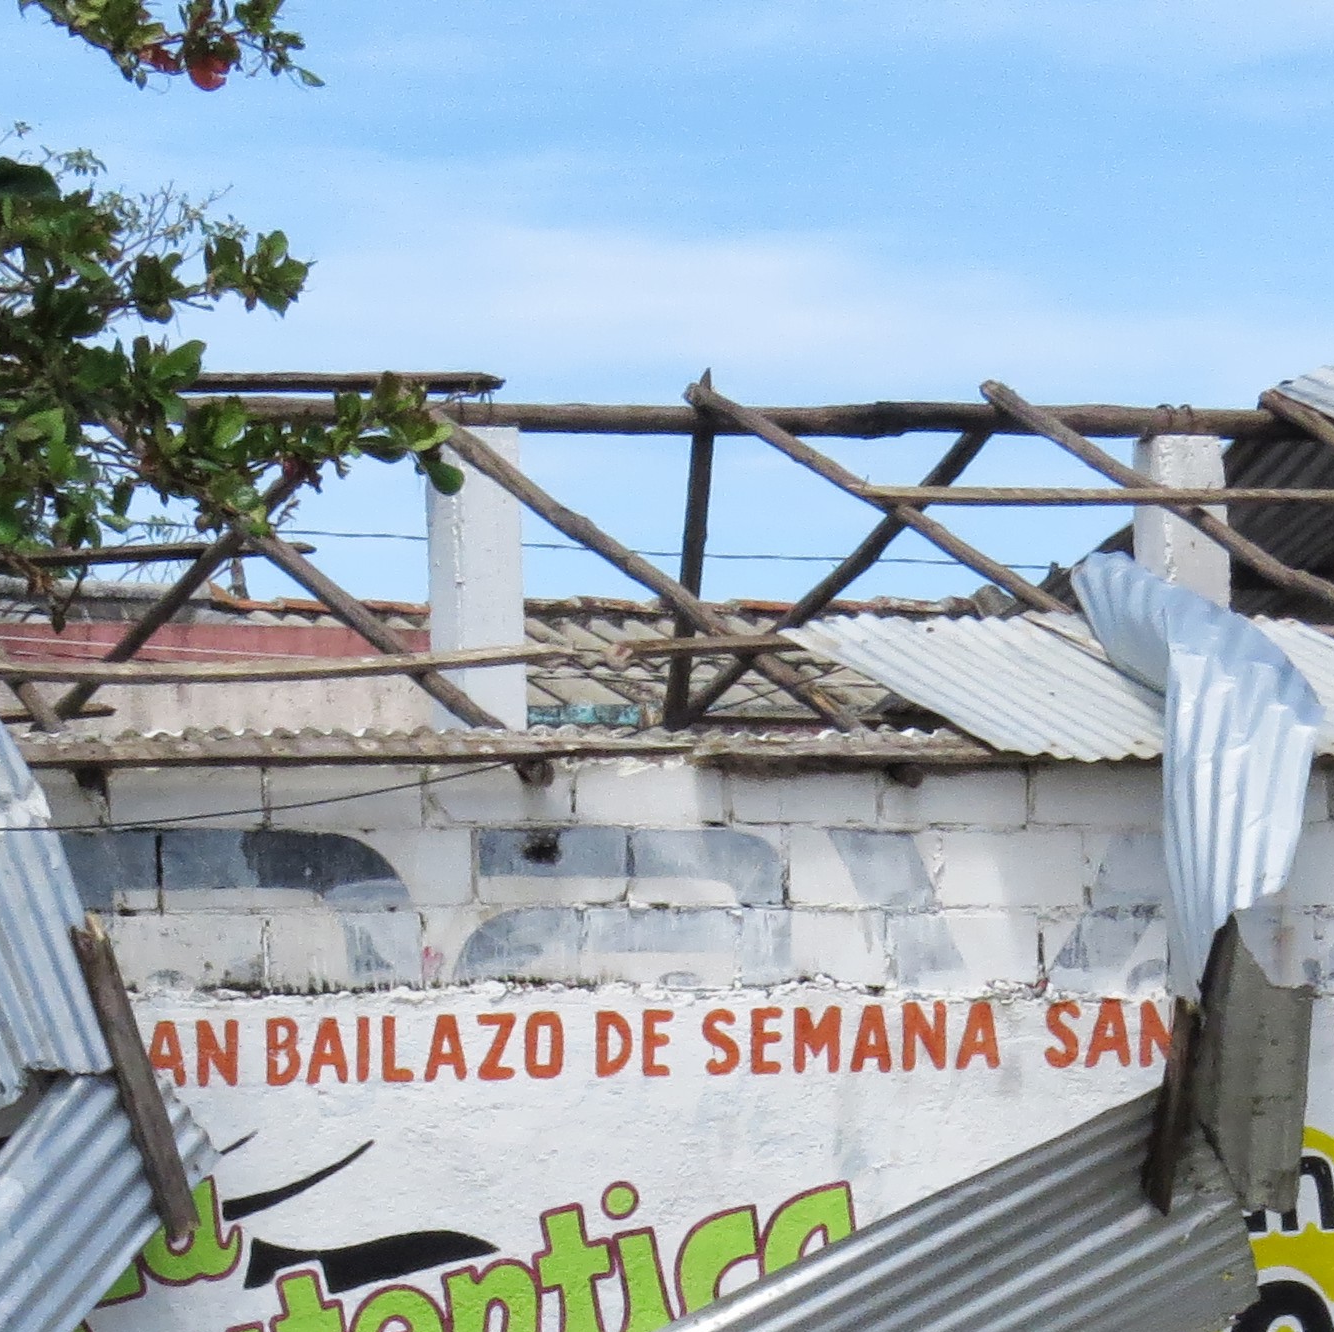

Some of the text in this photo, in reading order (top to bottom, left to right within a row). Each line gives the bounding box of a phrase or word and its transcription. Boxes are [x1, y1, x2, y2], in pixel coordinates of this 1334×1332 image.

[149, 998, 1174, 1087] AN BAILAZO DE SEMANA SAN
